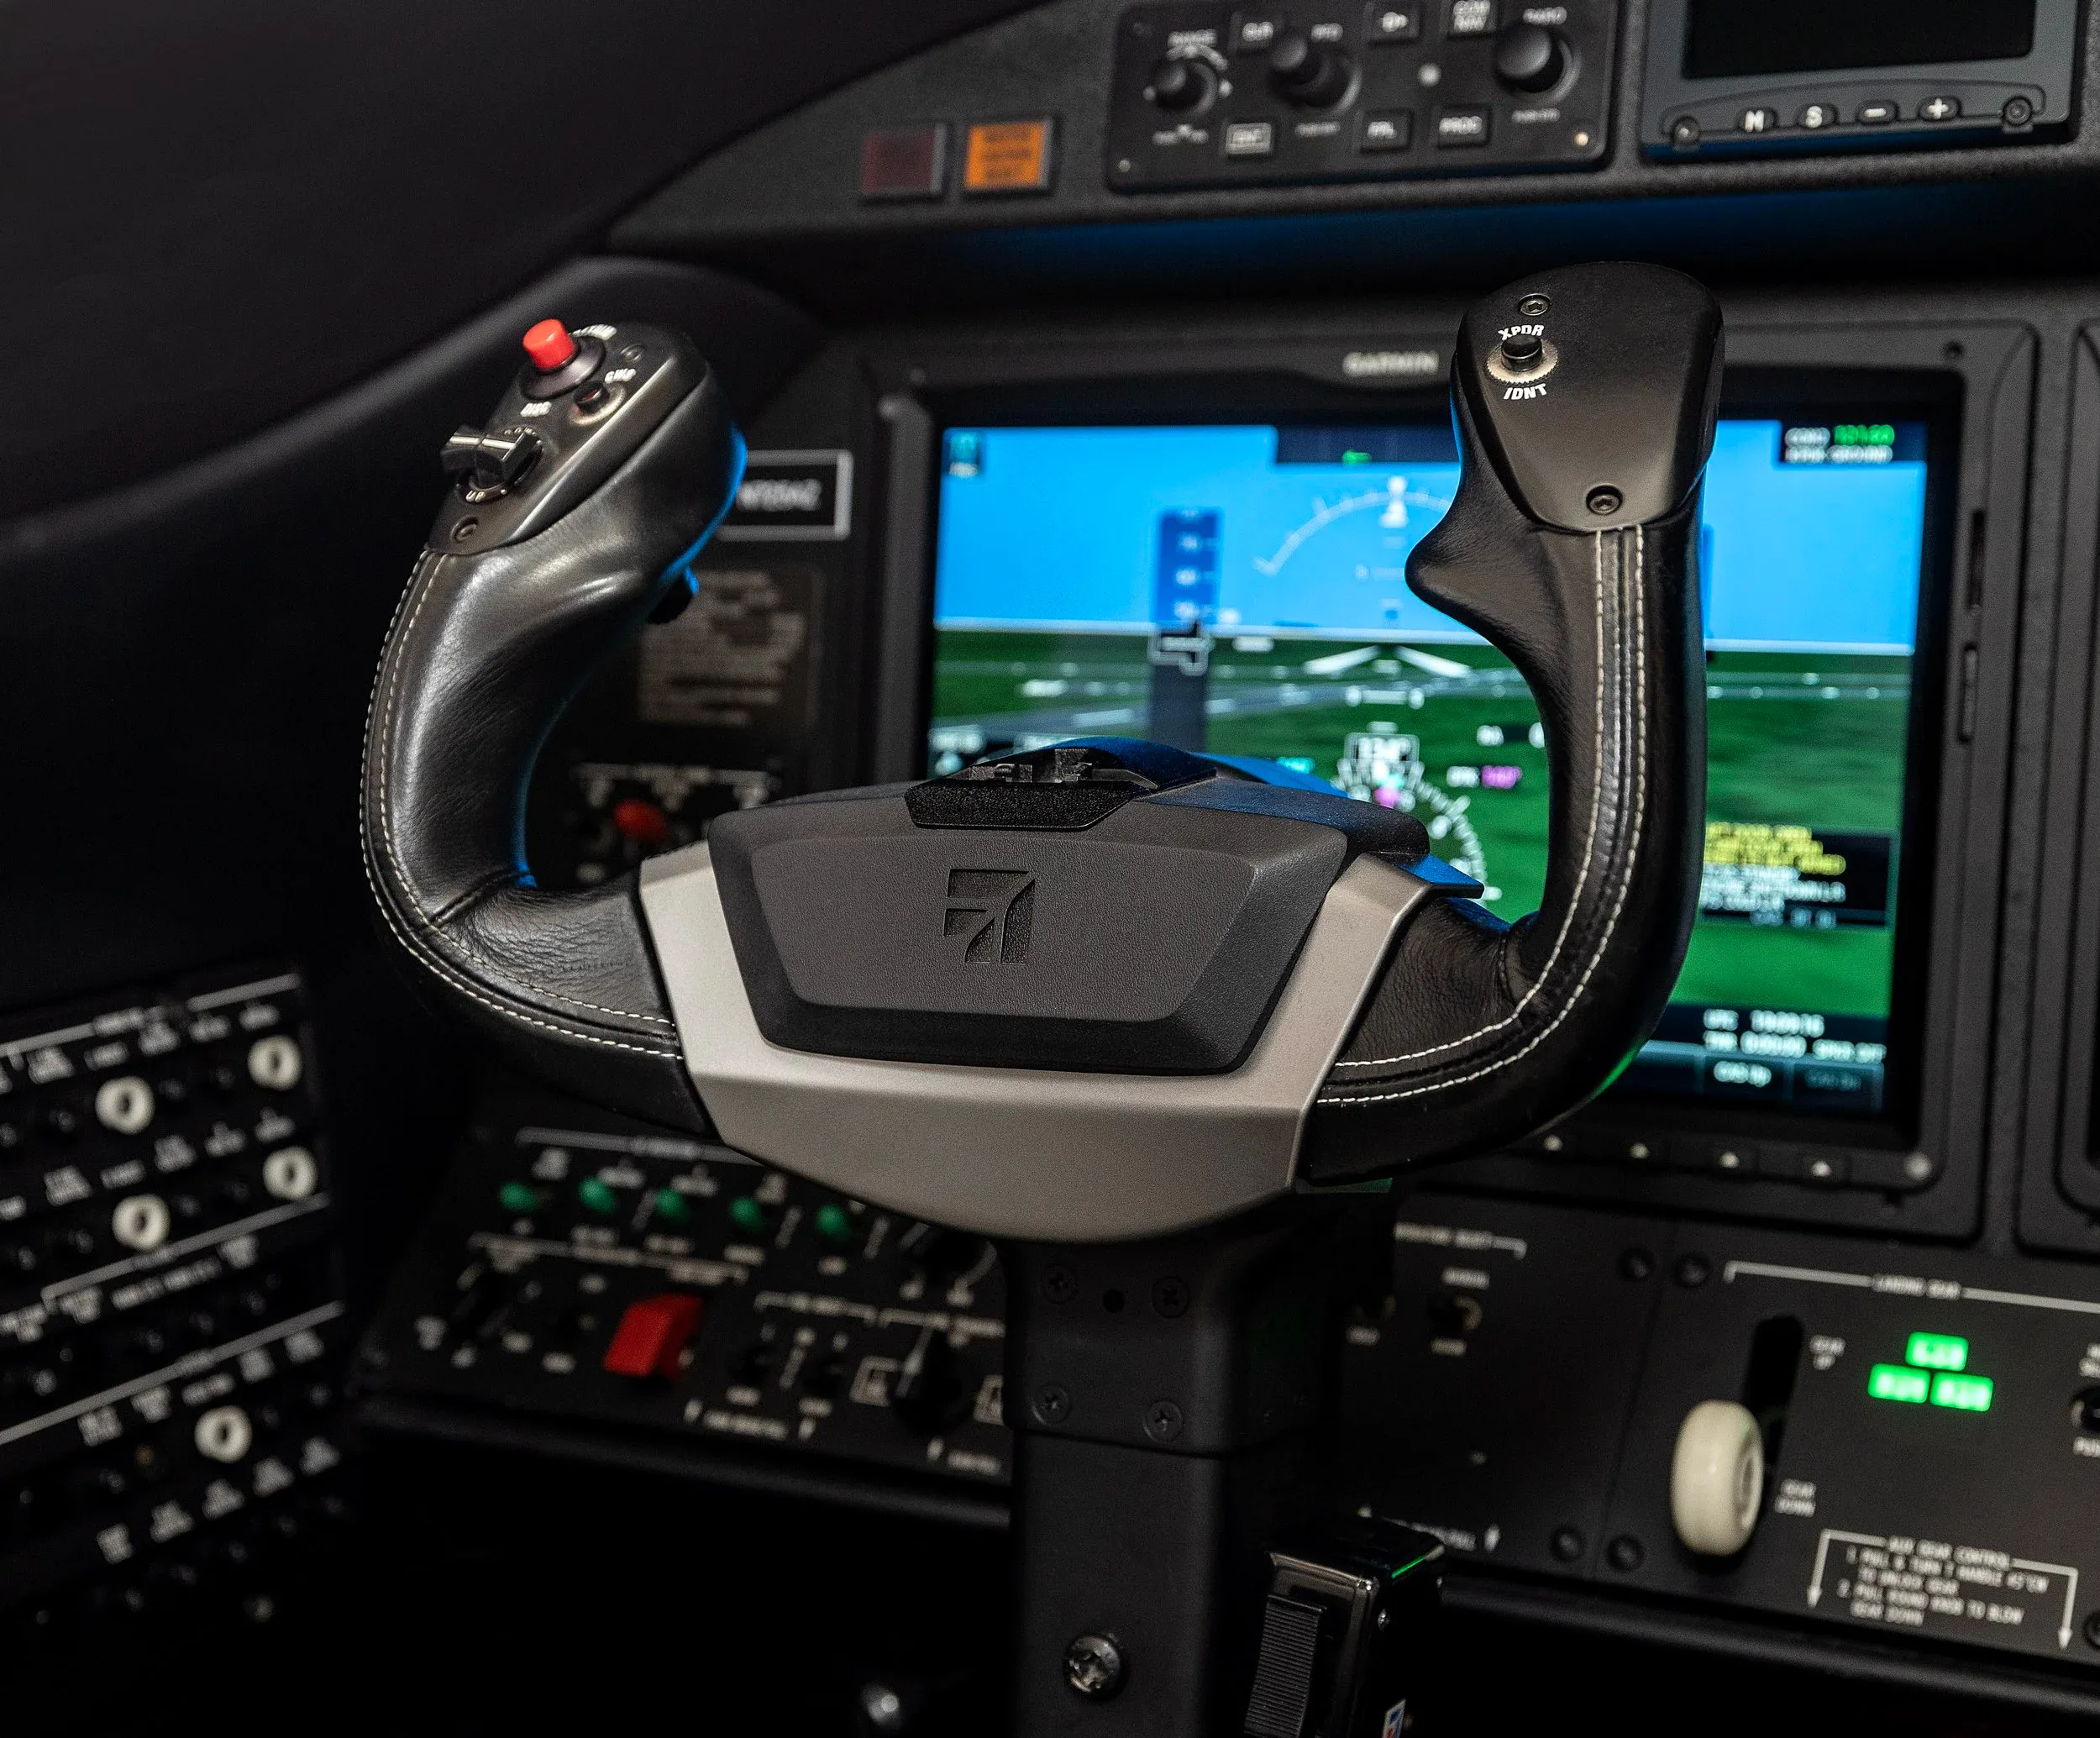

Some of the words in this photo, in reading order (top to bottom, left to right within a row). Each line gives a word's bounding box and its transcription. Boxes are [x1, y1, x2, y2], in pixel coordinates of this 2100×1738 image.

[1498, 324, 1545, 341] XPDR
[605, 368, 637, 384] CWS
[1503, 383, 1547, 400] IDNT
[520, 401, 553, 417] DISC
[465, 490, 486, 503] UP
